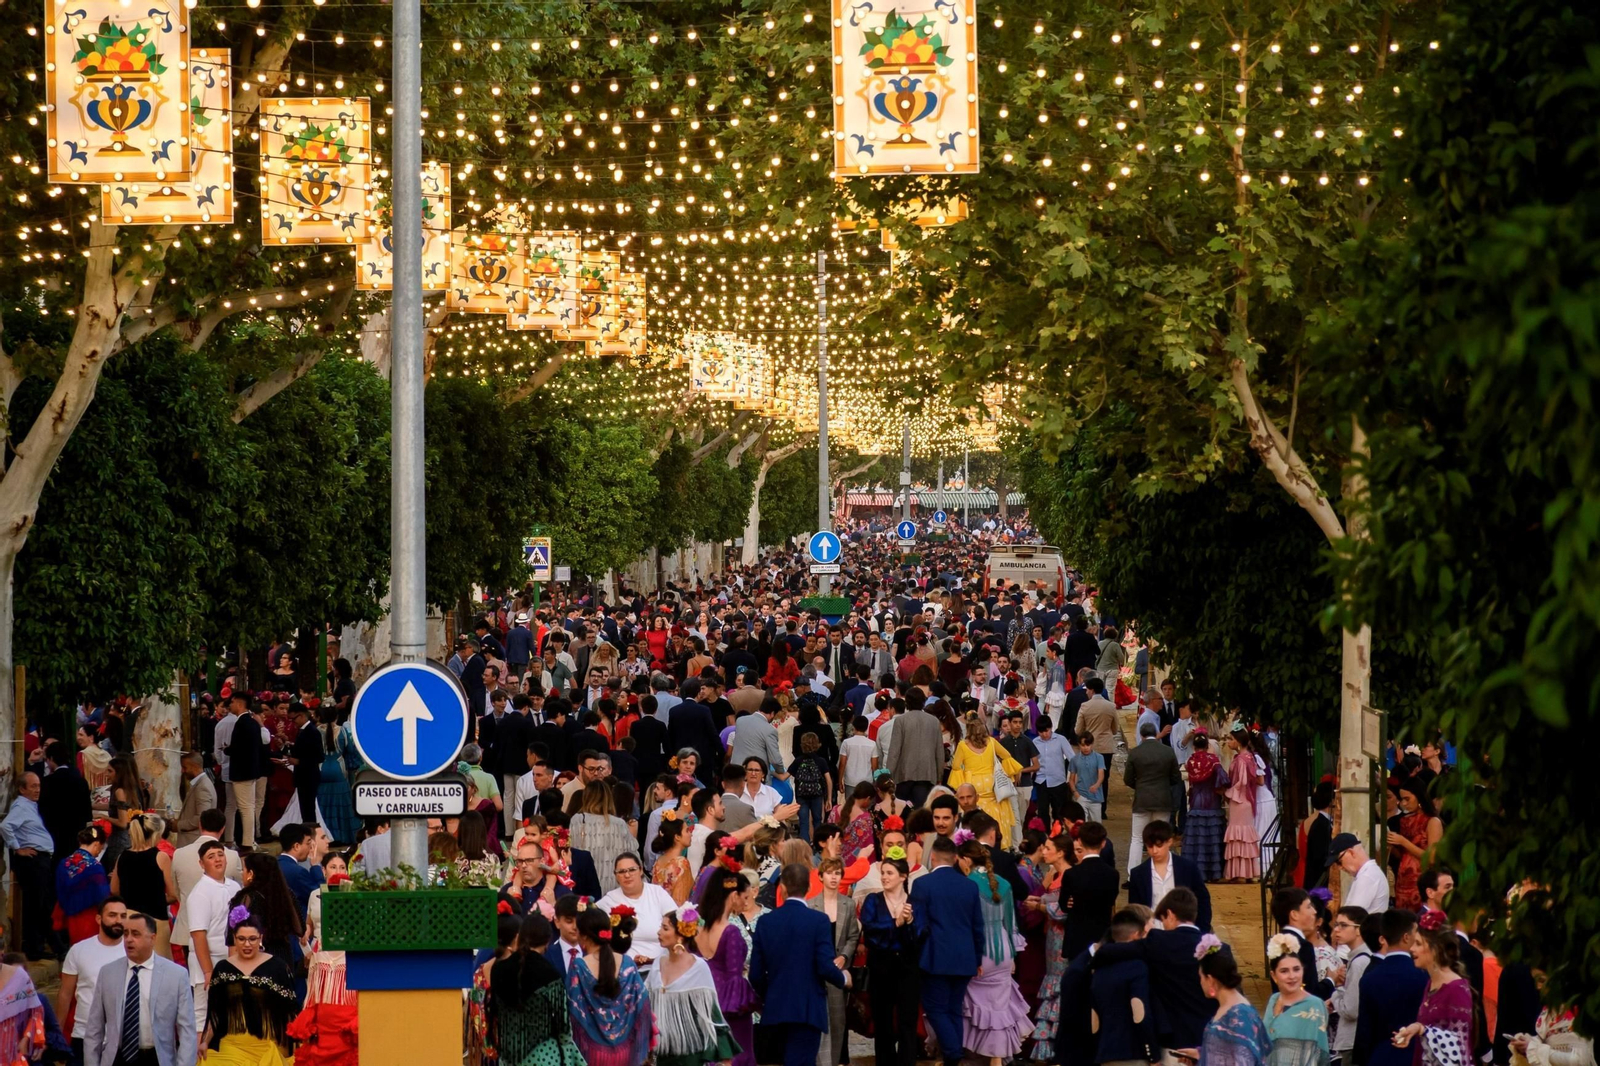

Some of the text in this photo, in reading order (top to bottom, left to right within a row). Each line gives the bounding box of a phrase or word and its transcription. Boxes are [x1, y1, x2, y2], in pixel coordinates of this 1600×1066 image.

[359, 787, 462, 797] PASEO DE CABALLOS
[377, 803, 444, 813] Y CARRUAJES
